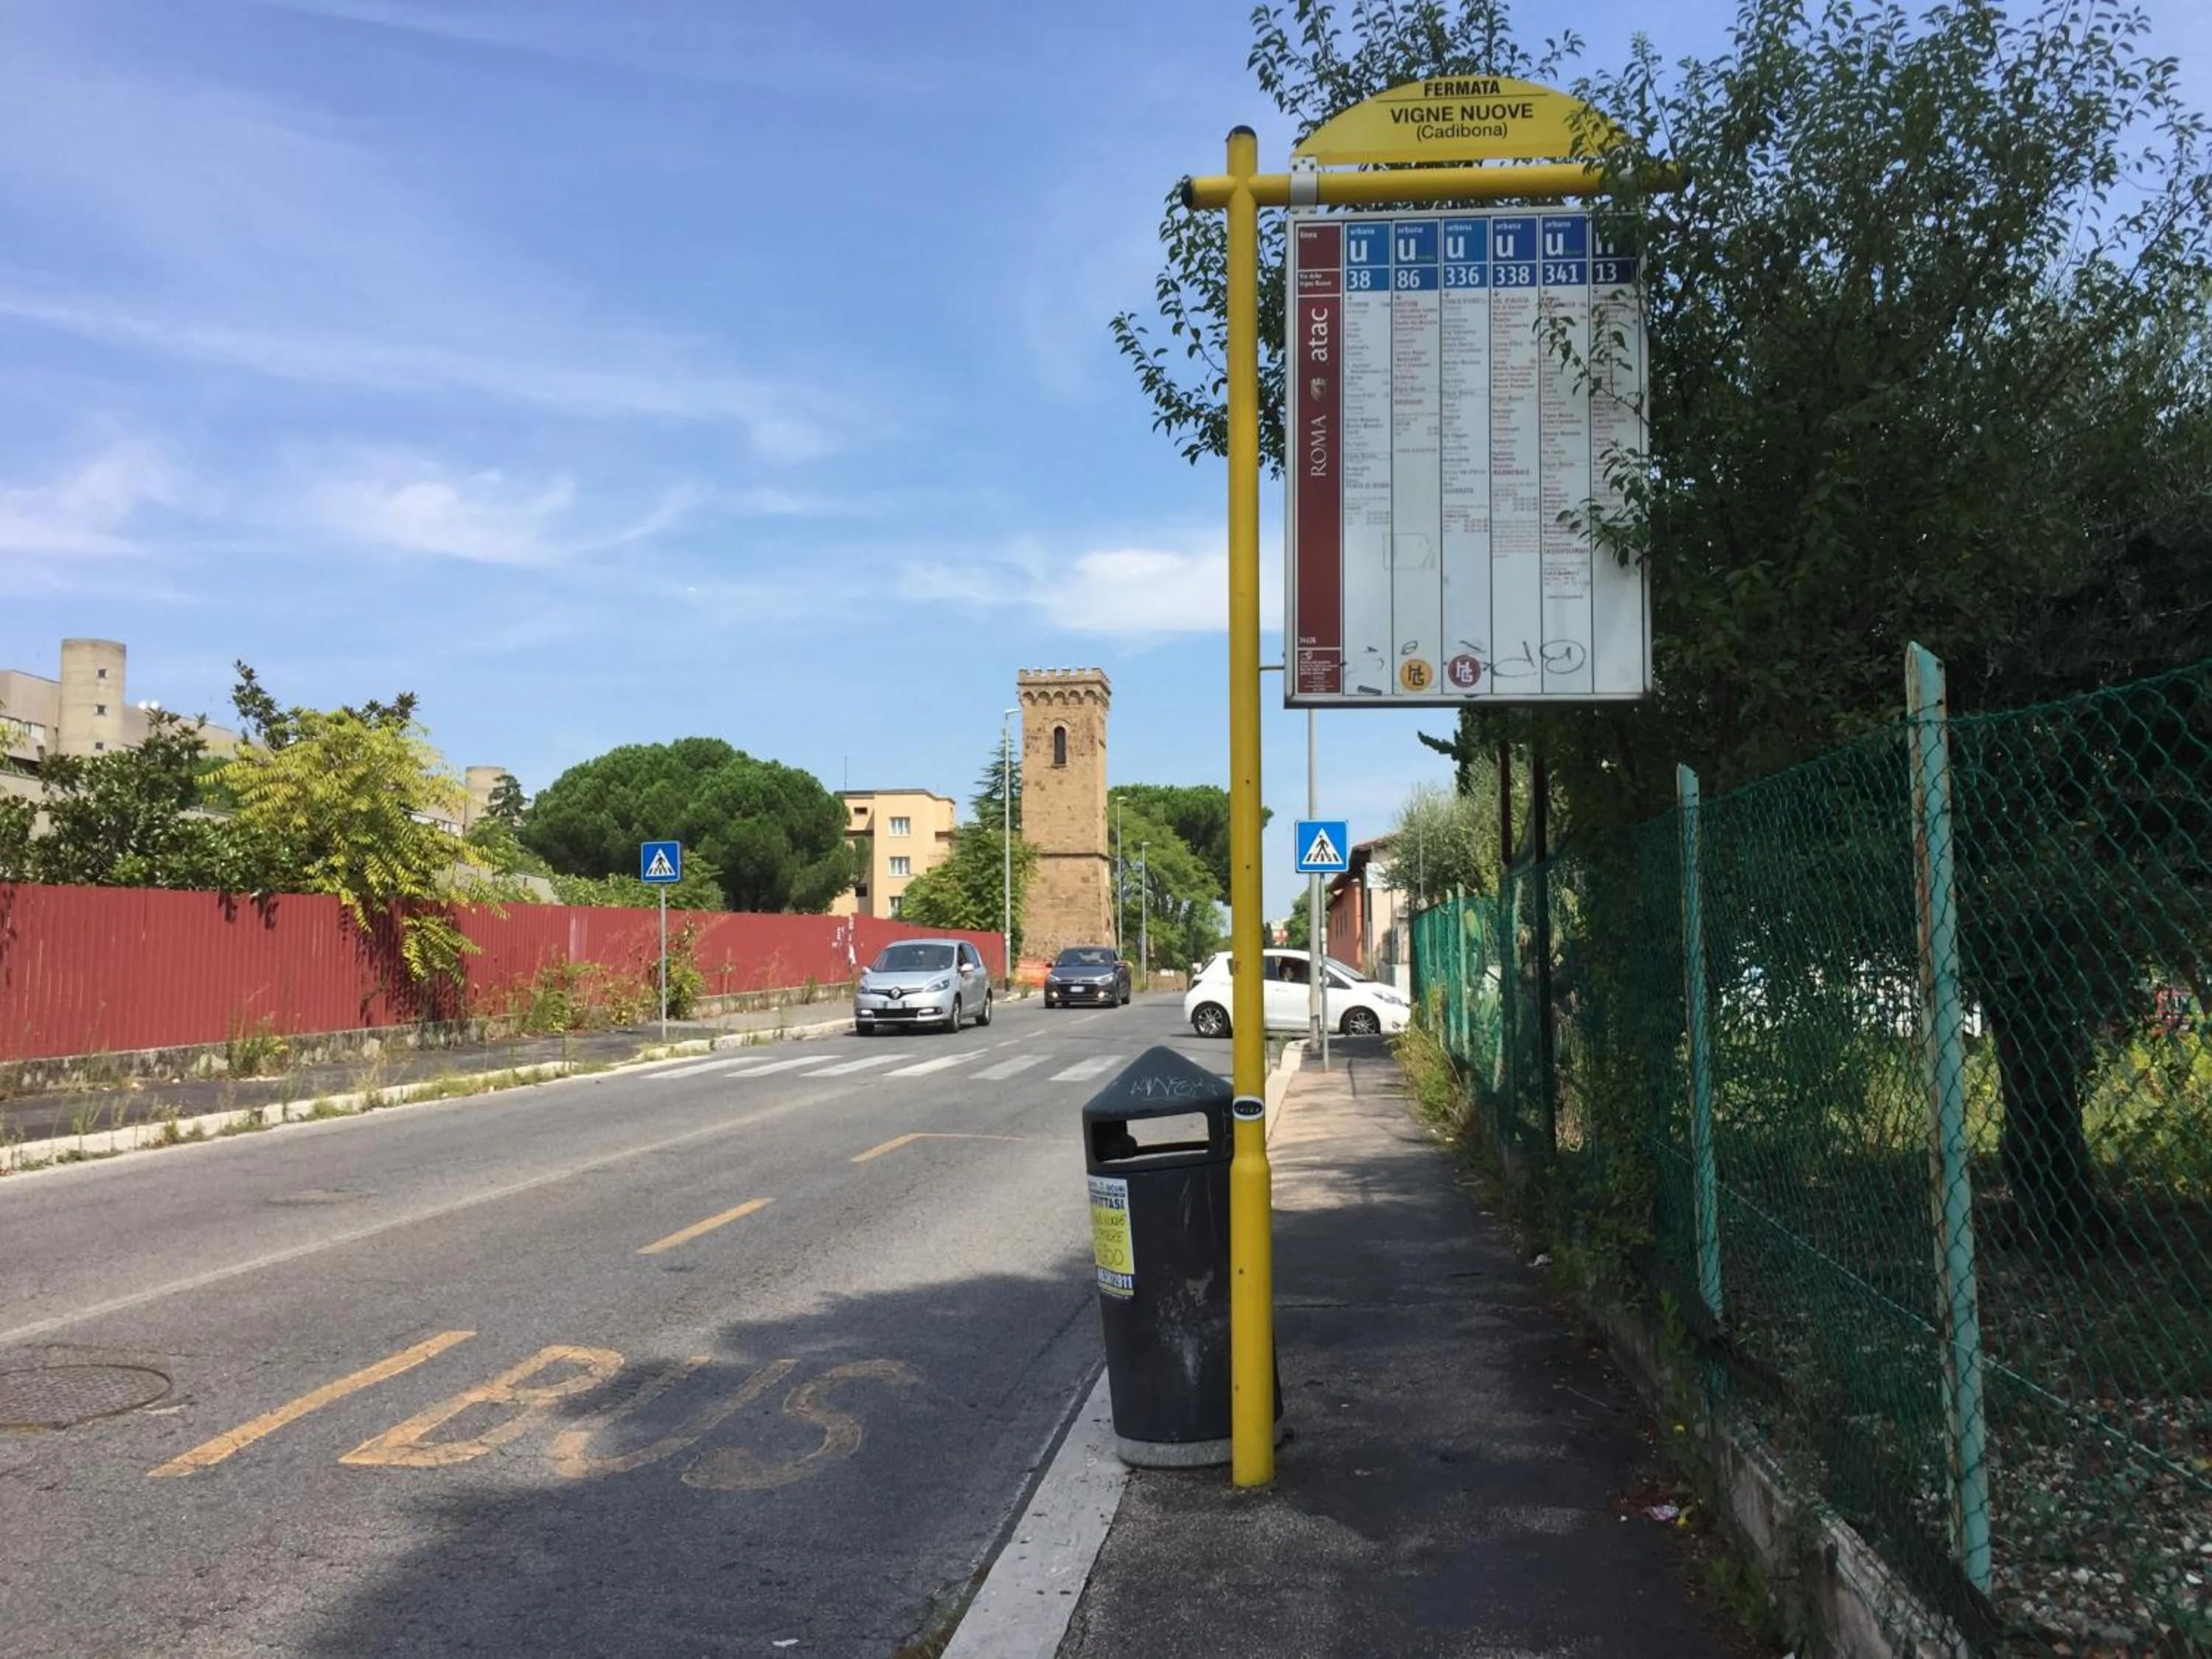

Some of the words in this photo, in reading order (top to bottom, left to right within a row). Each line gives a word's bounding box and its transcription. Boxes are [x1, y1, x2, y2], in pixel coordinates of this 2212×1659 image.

[1424, 80, 1500, 97] FERMATA
[1391, 105, 1454, 124] VIGNE
[1461, 103, 1534, 122] NUOVE
[1416, 122, 1508, 142] (Cadibona)
[1349, 270, 1371, 289] 38
[1397, 269, 1420, 288] 86
[1445, 265, 1480, 286] 336
[1496, 265, 1530, 285] 338
[1545, 264, 1579, 283] 341
[1595, 262, 1617, 282] 13
[1309, 307, 1328, 361] atac
[1310, 414, 1327, 476] ROMA
[338, 1343, 926, 1490] BUS
